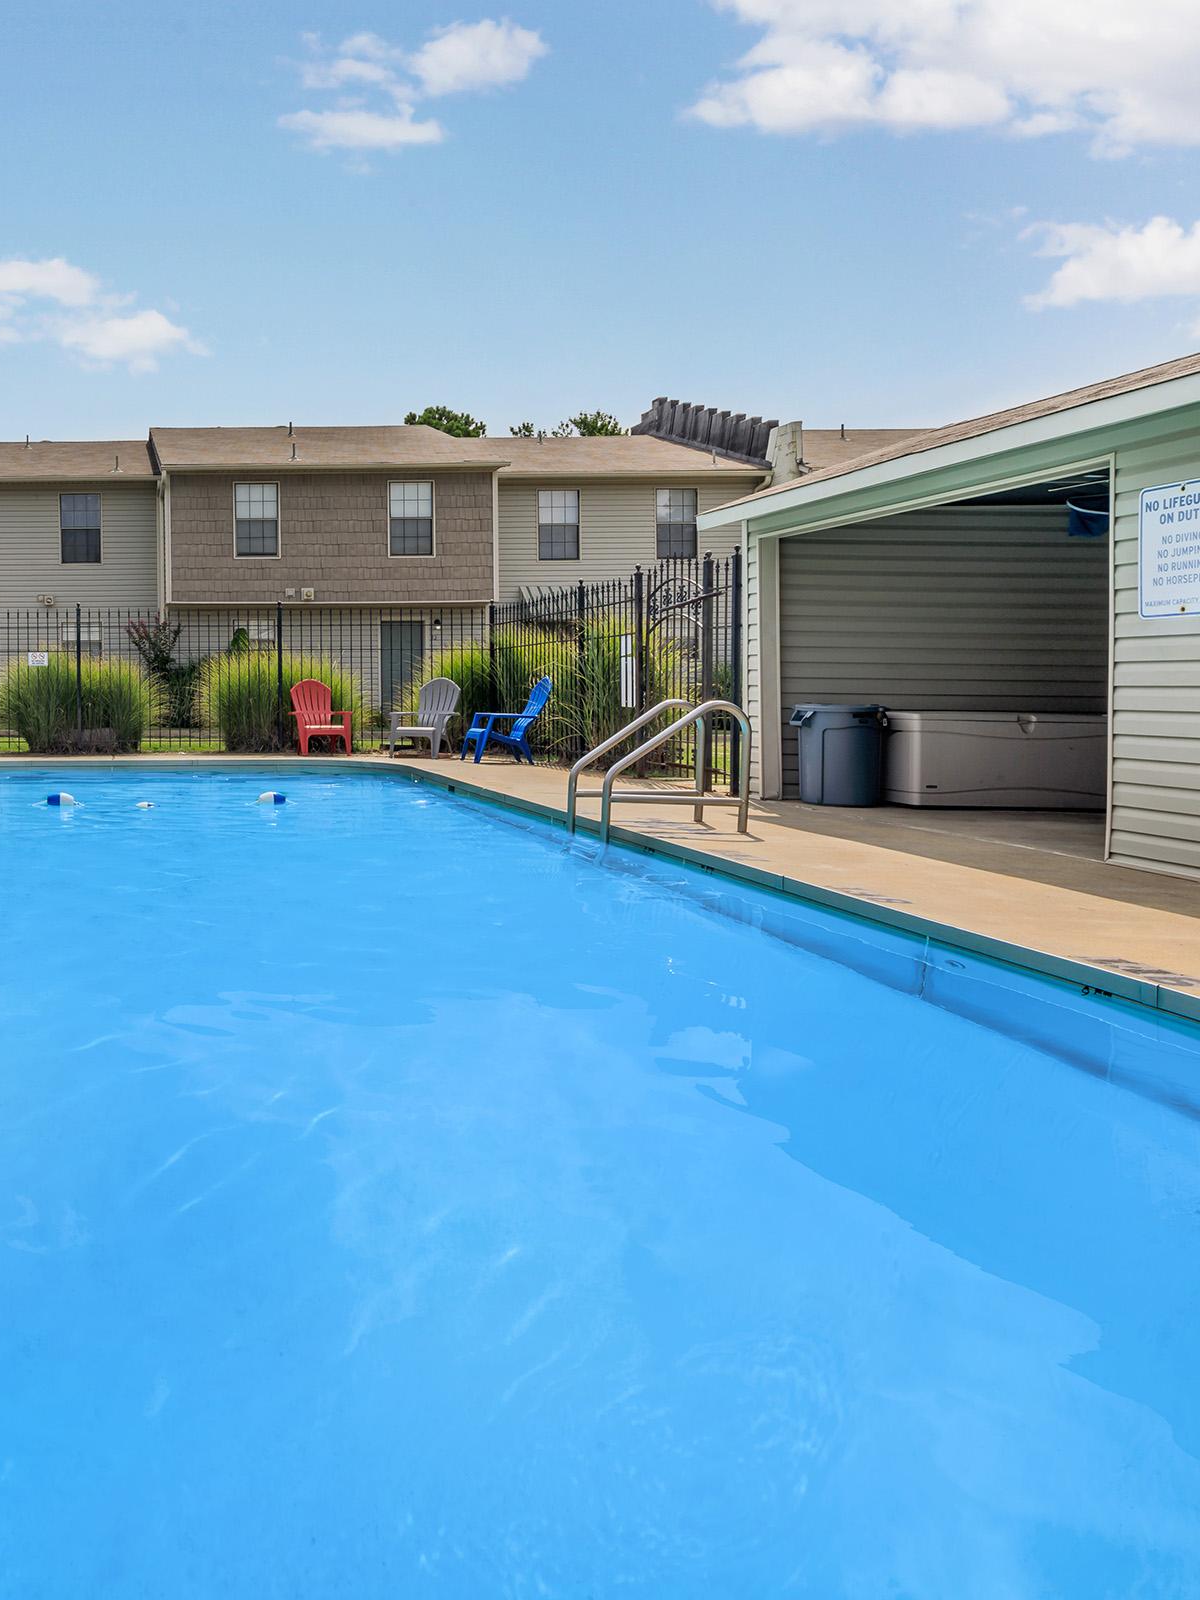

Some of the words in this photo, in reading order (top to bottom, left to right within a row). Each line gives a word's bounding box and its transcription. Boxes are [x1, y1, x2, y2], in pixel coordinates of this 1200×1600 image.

[1145, 500, 1160, 513] NO
[1163, 493, 1200, 510] LIFEGU
[1159, 512, 1174, 525] ON
[1178, 508, 1200, 522] DUT
[1161, 534, 1173, 545] NO
[1175, 531, 1200, 543] DIVIN
[1157, 549, 1169, 559] NO
[1157, 562, 1169, 572] NO
[1152, 576, 1164, 586] NO
[1166, 572, 1200, 585] HORSEP
